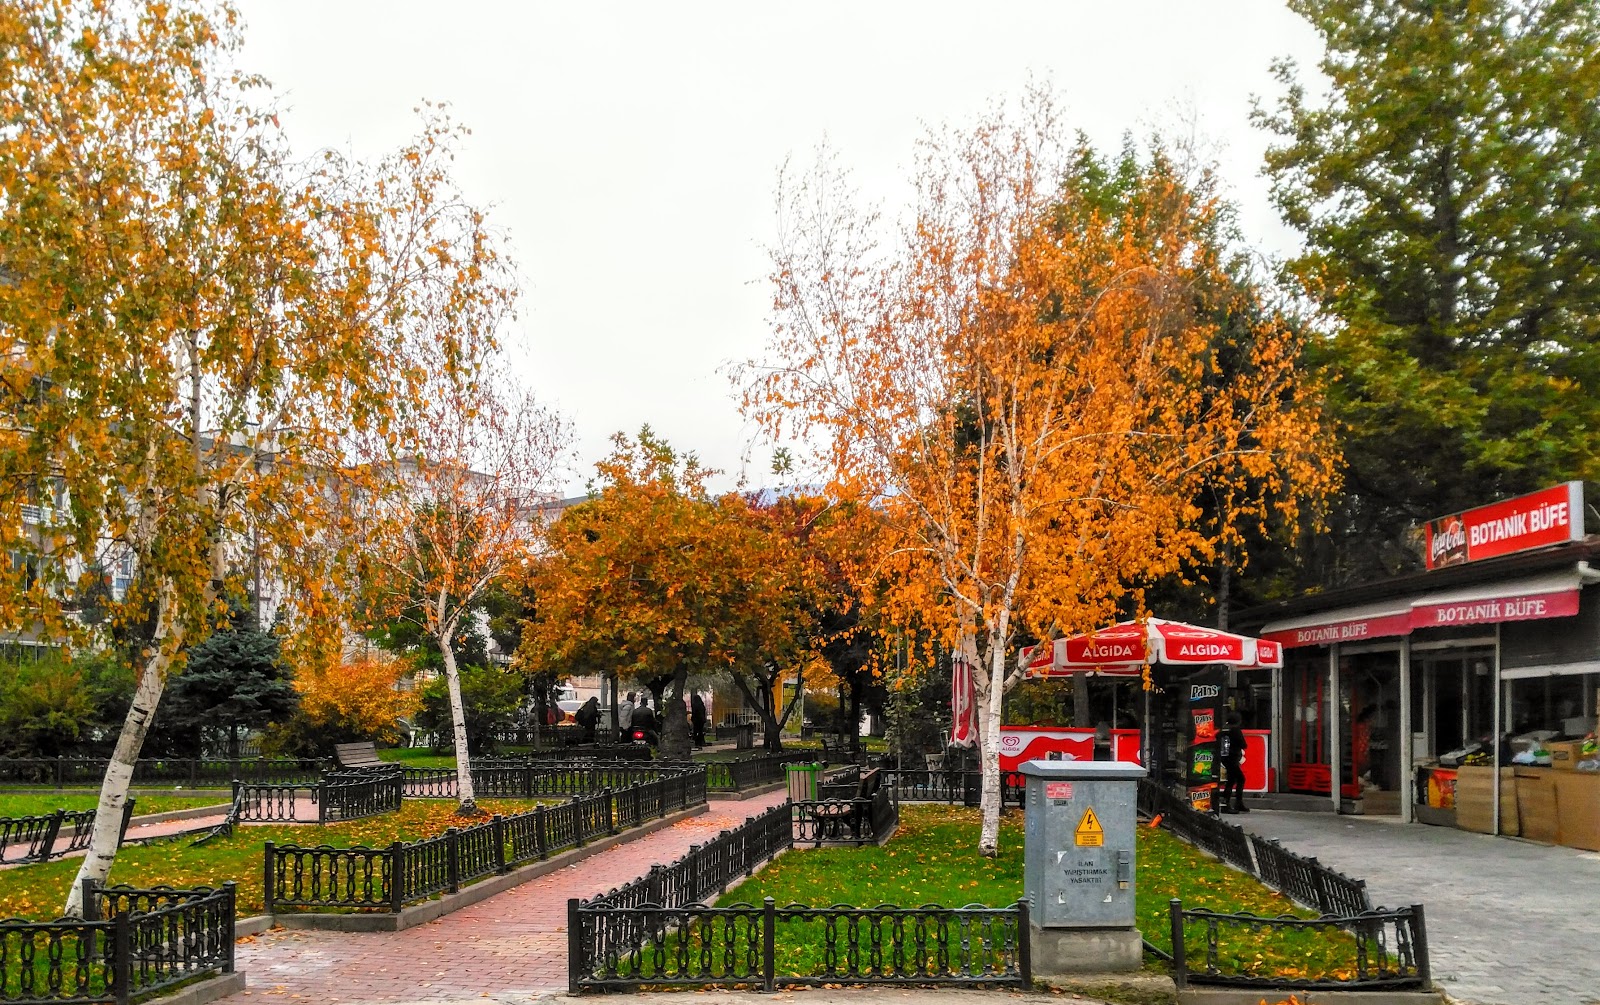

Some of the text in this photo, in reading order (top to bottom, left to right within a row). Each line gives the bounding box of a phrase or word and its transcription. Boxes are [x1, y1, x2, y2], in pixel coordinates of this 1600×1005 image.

[1471, 502, 1568, 547] BOTANİK BÜFE
[1437, 599, 1547, 623] BOTANİK BÜFE
[1297, 622, 1368, 643] BOTANİK BÜFE
